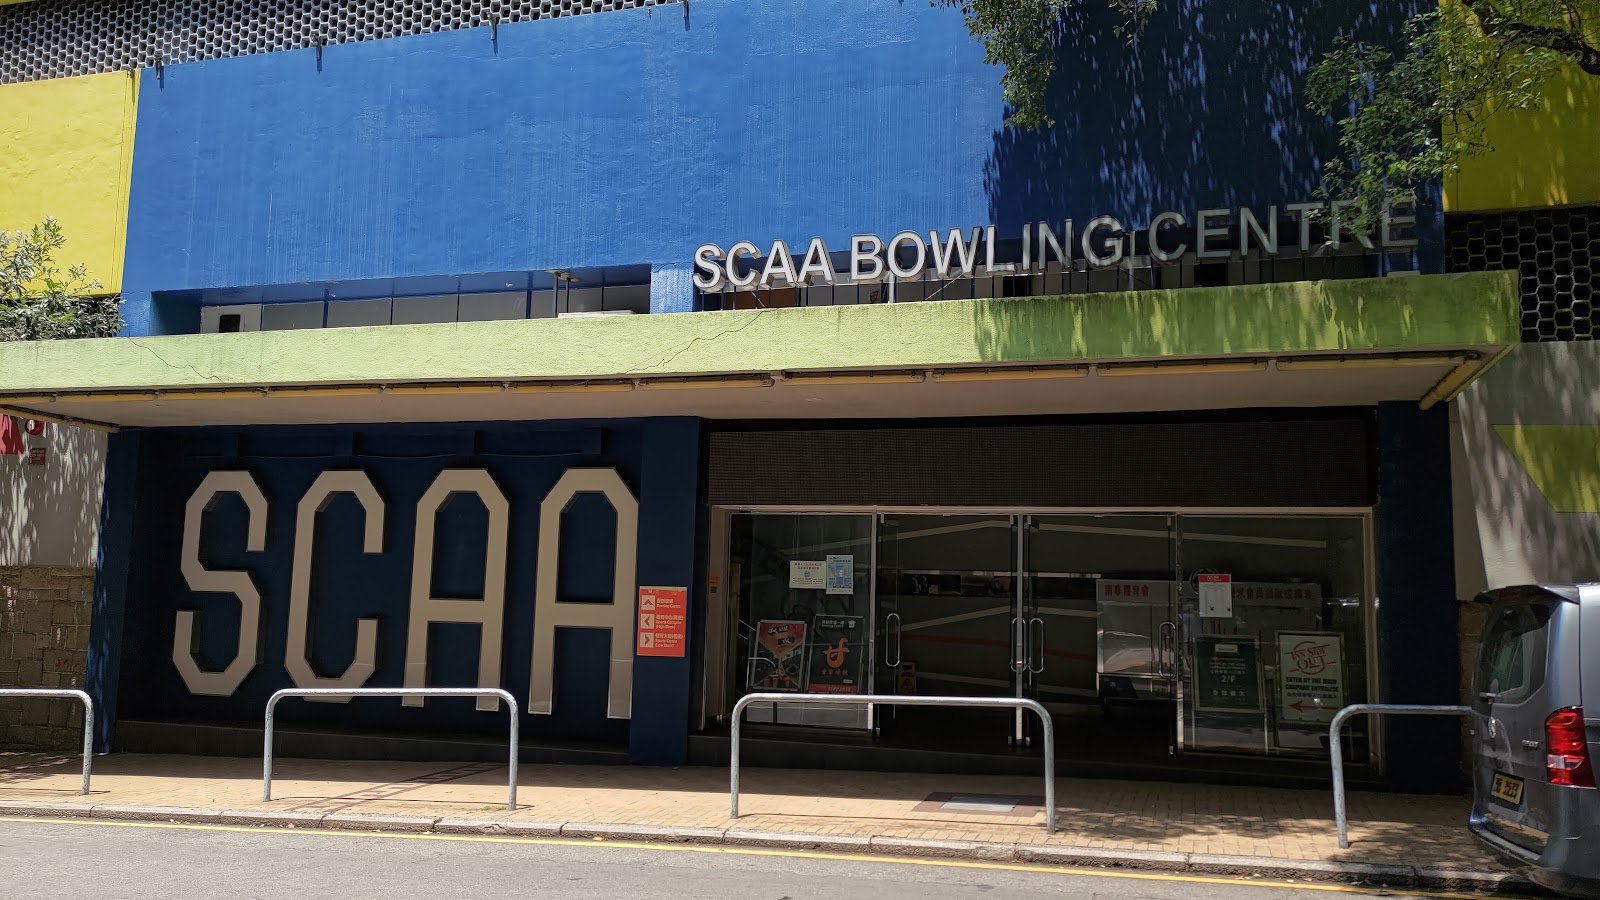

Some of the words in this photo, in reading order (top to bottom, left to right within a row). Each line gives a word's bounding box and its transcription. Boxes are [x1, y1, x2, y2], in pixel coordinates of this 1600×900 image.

[693, 237, 837, 292] SCAA
[850, 214, 1124, 283] BOWLING
[1148, 195, 1419, 264] CENTRE
[172, 467, 640, 719] SCAA
